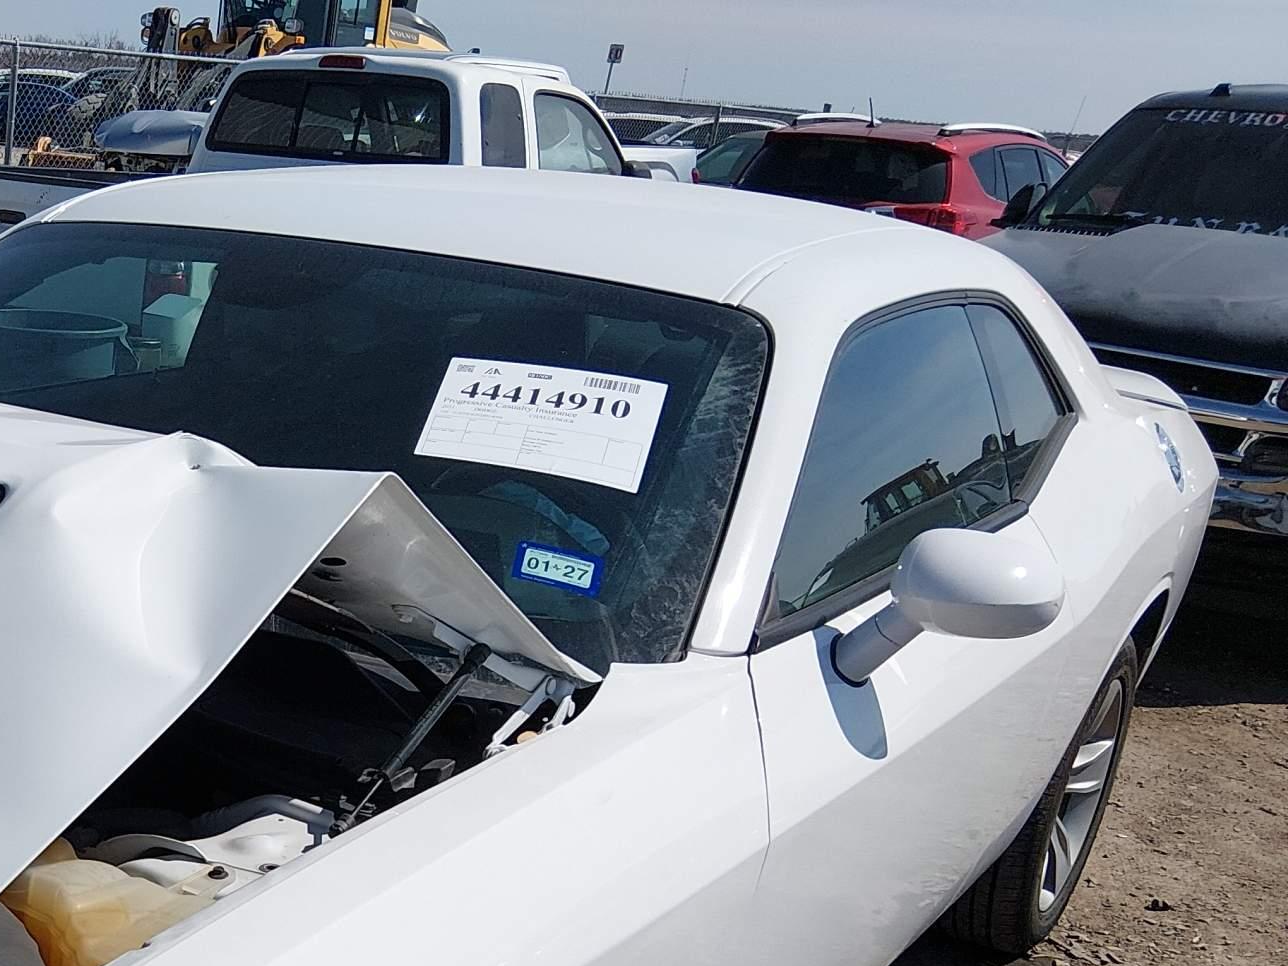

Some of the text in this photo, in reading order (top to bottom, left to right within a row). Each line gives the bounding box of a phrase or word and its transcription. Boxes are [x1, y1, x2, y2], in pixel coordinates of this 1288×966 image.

[1166, 109, 1288, 130] CHEVRO
[443, 397, 493, 408] Progressive
[495, 402, 534, 414] Casualty
[535, 405, 578, 418] Insurance
[460, 381, 631, 419] 44414910
